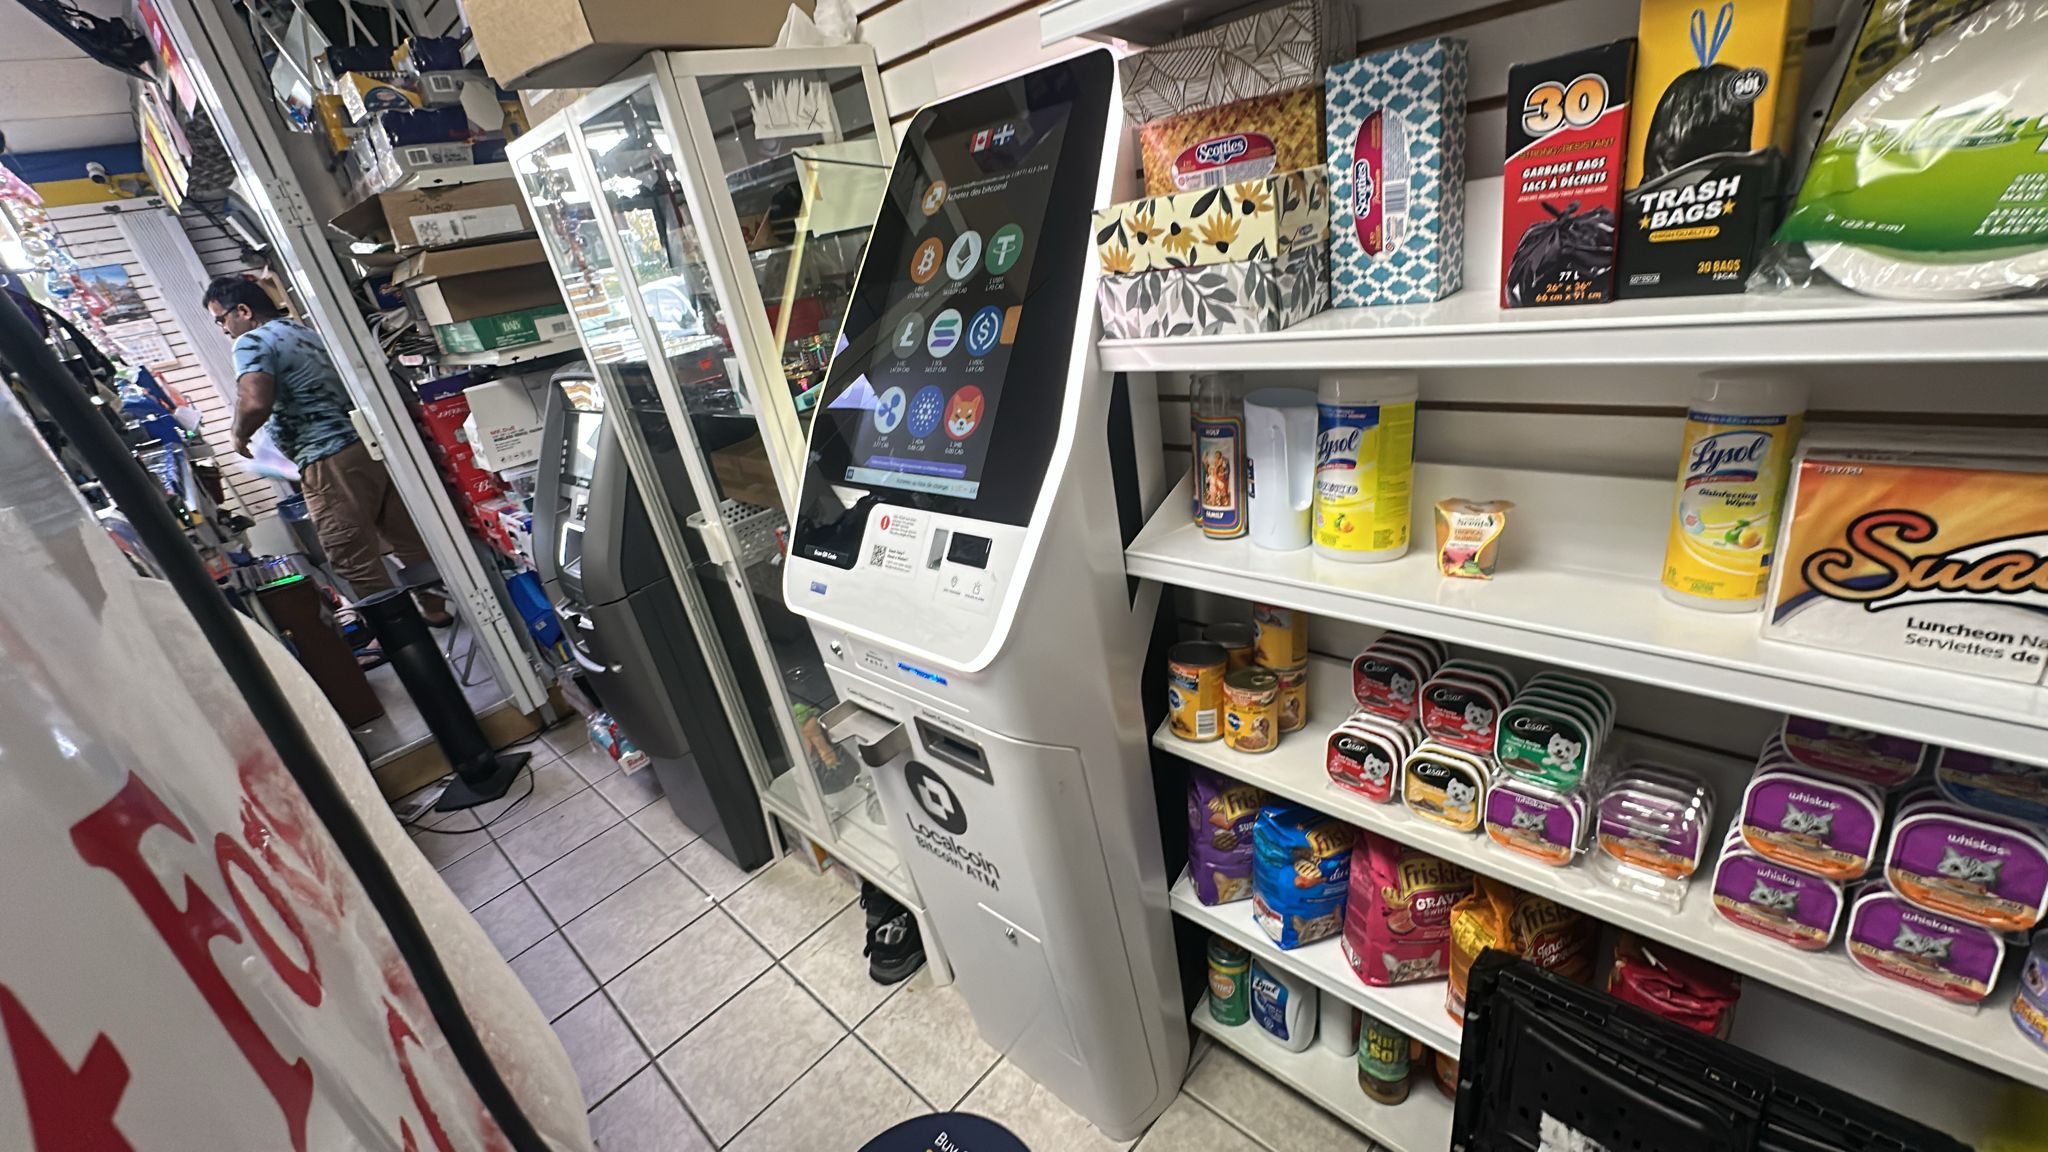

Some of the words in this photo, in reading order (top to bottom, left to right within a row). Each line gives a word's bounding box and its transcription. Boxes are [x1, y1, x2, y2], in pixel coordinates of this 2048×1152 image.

[1522, 72, 1609, 137] 30
[1197, 137, 1246, 162] Scotties
[1522, 162, 1573, 179] GARBAGE
[1575, 157, 1607, 171] BAGS
[970, 187, 981, 197] des
[1356, 163, 1370, 217] Scotties
[1521, 180, 1547, 193] SACS
[1548, 175, 1558, 190] À
[1560, 171, 1608, 188] DÉCHETS
[1640, 175, 1741, 213] TRASH
[1650, 199, 1723, 230] BAGS
[1559, 270, 1571, 281] 77
[1573, 270, 1580, 280] L
[1713, 259, 1741, 272] BAGS
[1317, 429, 1359, 463] Lysol
[1690, 436, 1765, 474] Lysol
[1699, 487, 1759, 501] Disinfecting
[1725, 498, 1756, 508] Wipes
[1906, 616, 2014, 645] Luncheon
[1905, 633, 2004, 660] Serviettes
[2012, 650, 2040, 665] de
[1364, 660, 1389, 673] Cesar
[1434, 688, 1463, 701] Cesar
[1515, 717, 1550, 732] Cesar
[1339, 738, 1366, 751] Cesar
[1417, 763, 1448, 777] Cesar
[1788, 790, 1837, 811] whiskas
[906, 812, 1000, 880] Localcoin
[1947, 833, 2005, 856] whiskas
[915, 834, 963, 871] Bitcoin
[966, 864, 1000, 892] ATM
[1757, 867, 1800, 888] whiskas
[1902, 911, 1957, 934] whiskas
